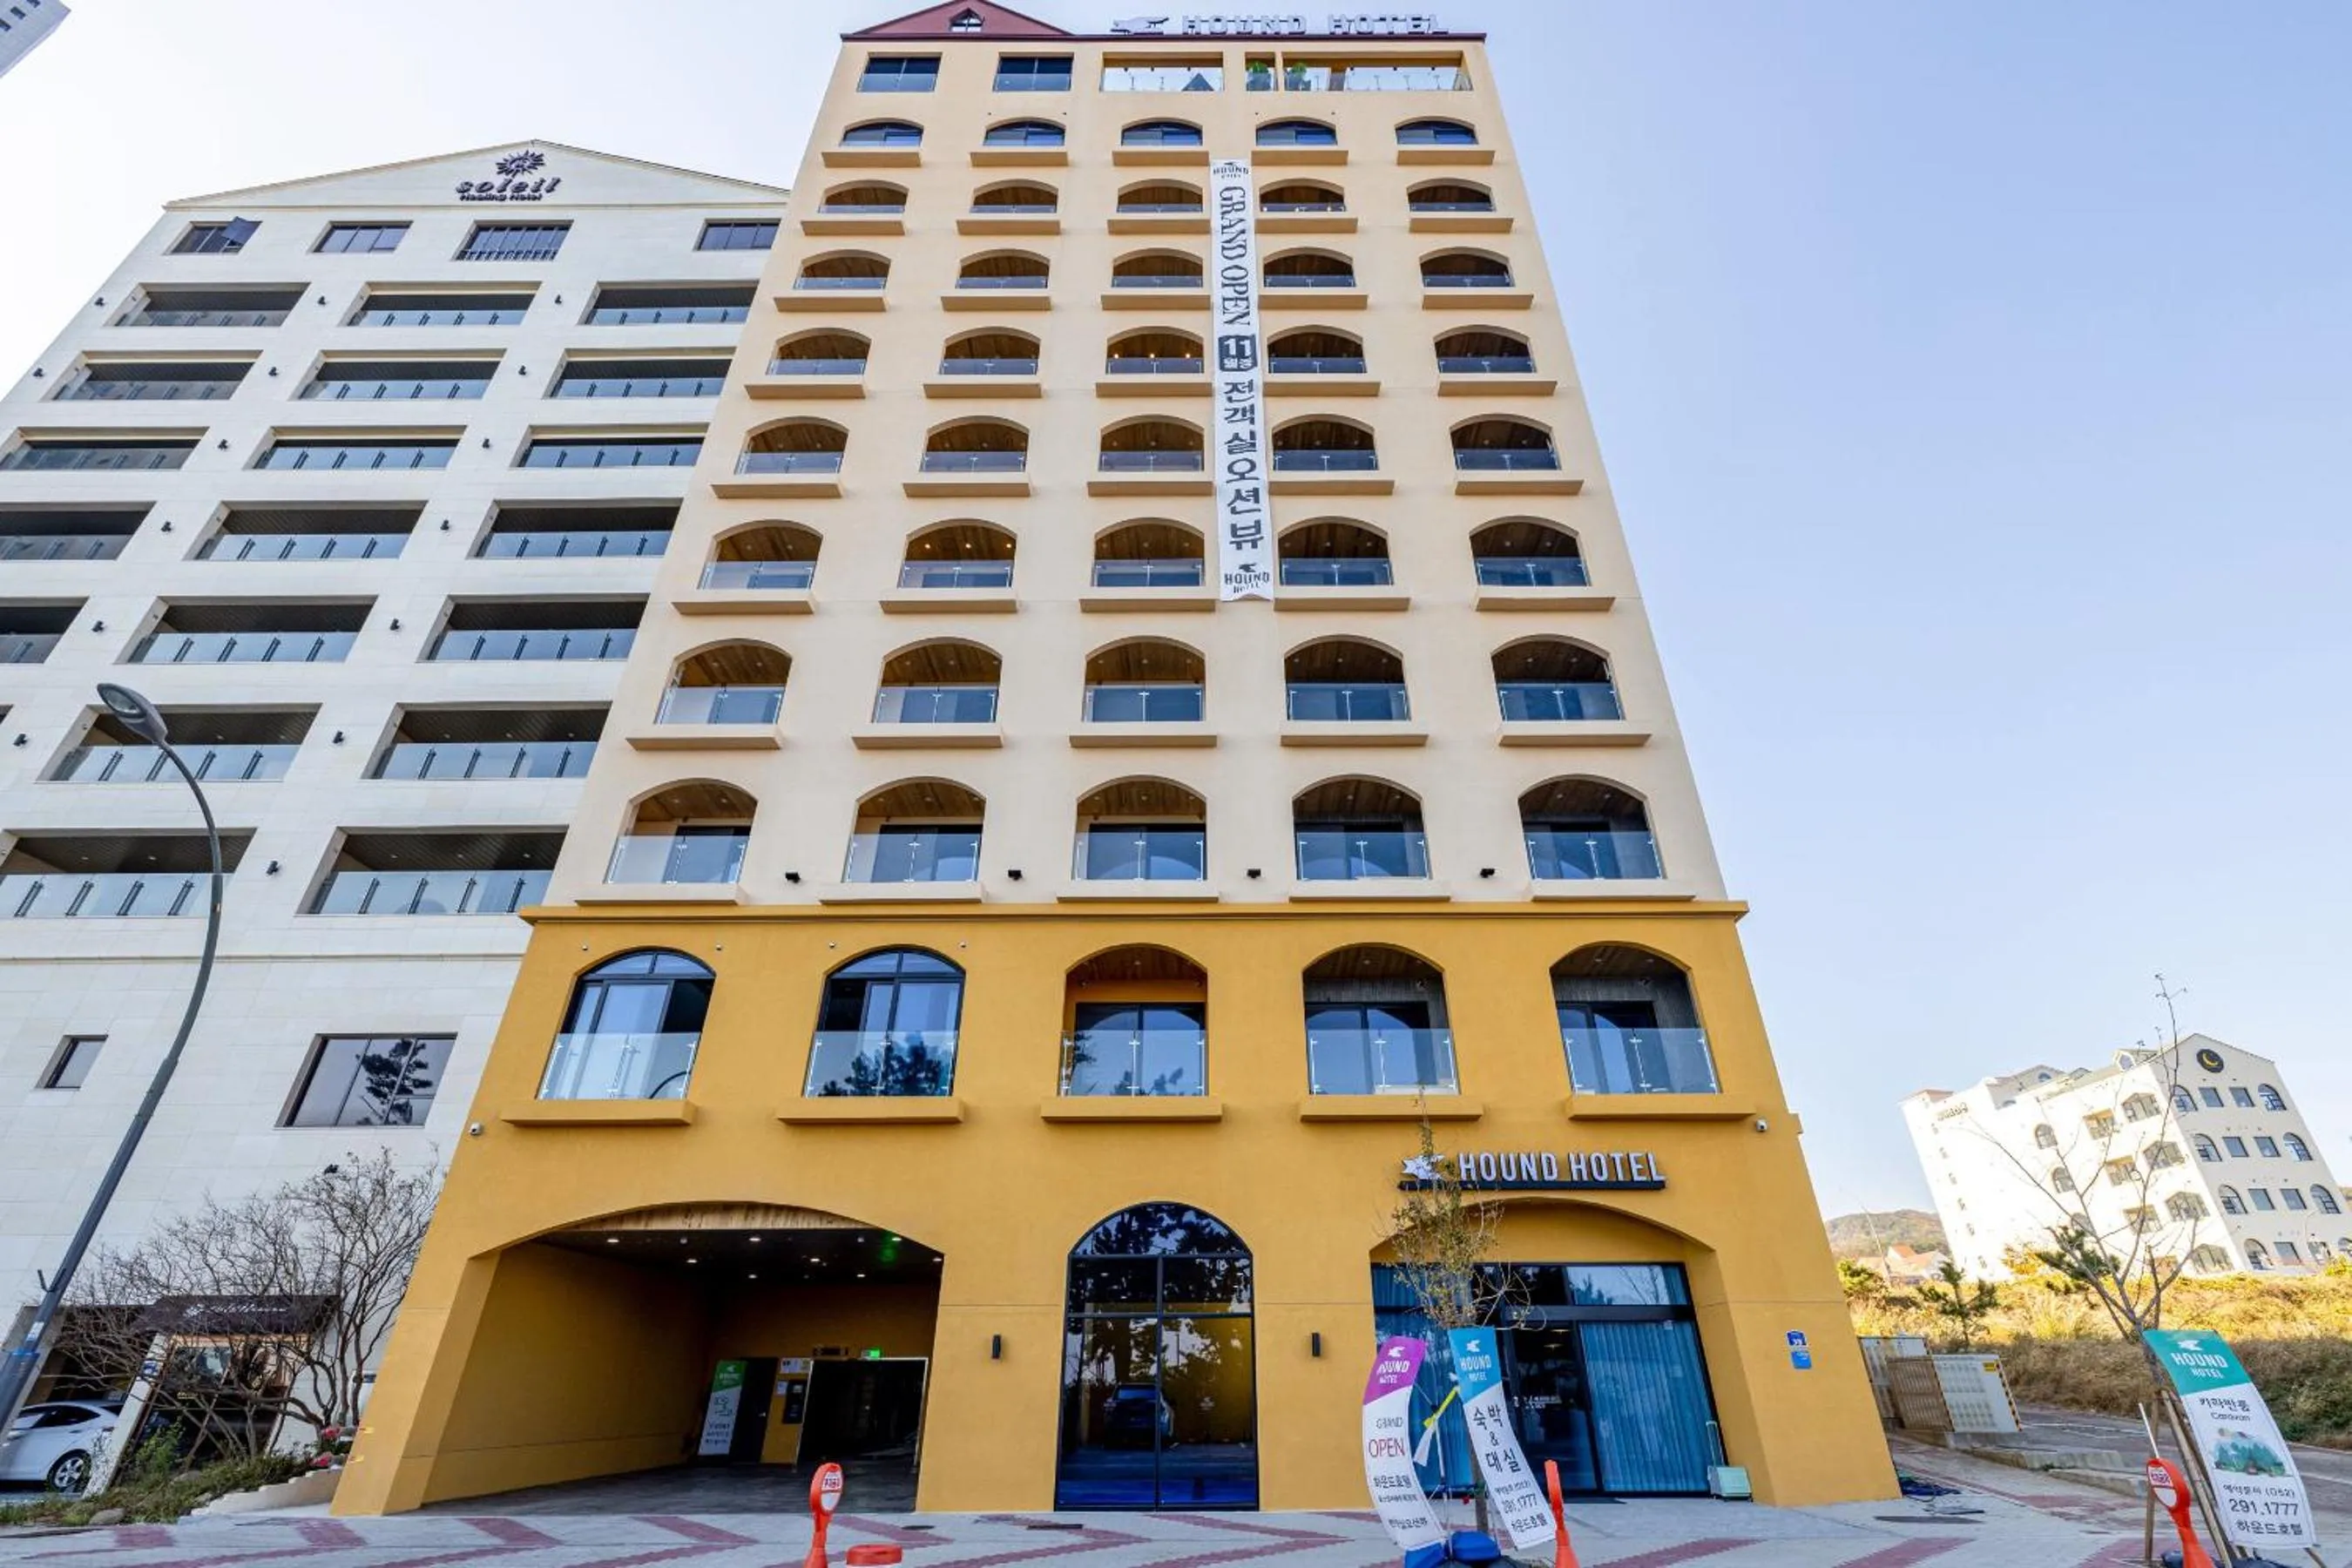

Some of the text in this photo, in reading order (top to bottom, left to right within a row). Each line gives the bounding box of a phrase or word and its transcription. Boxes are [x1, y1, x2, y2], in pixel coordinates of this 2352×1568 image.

[1182, 14, 1450, 35] HOUND HOTEL
[1220, 186, 1251, 327] GRAND OPEN
[1223, 338, 1252, 356] 11
[1224, 571, 1269, 585] HOUND
[1457, 1152, 1666, 1182] HOUND HOTEL
[1460, 1354, 1492, 1370] HOUND
[2170, 1352, 2229, 1368] HOUND
[2190, 1367, 2225, 1379] HOTEL
[1473, 1403, 1504, 1430] 숙박
[1369, 1437, 1406, 1457] OPEN
[1485, 1447, 1522, 1473] 대실
[2228, 1497, 2299, 1516] 291.1777
